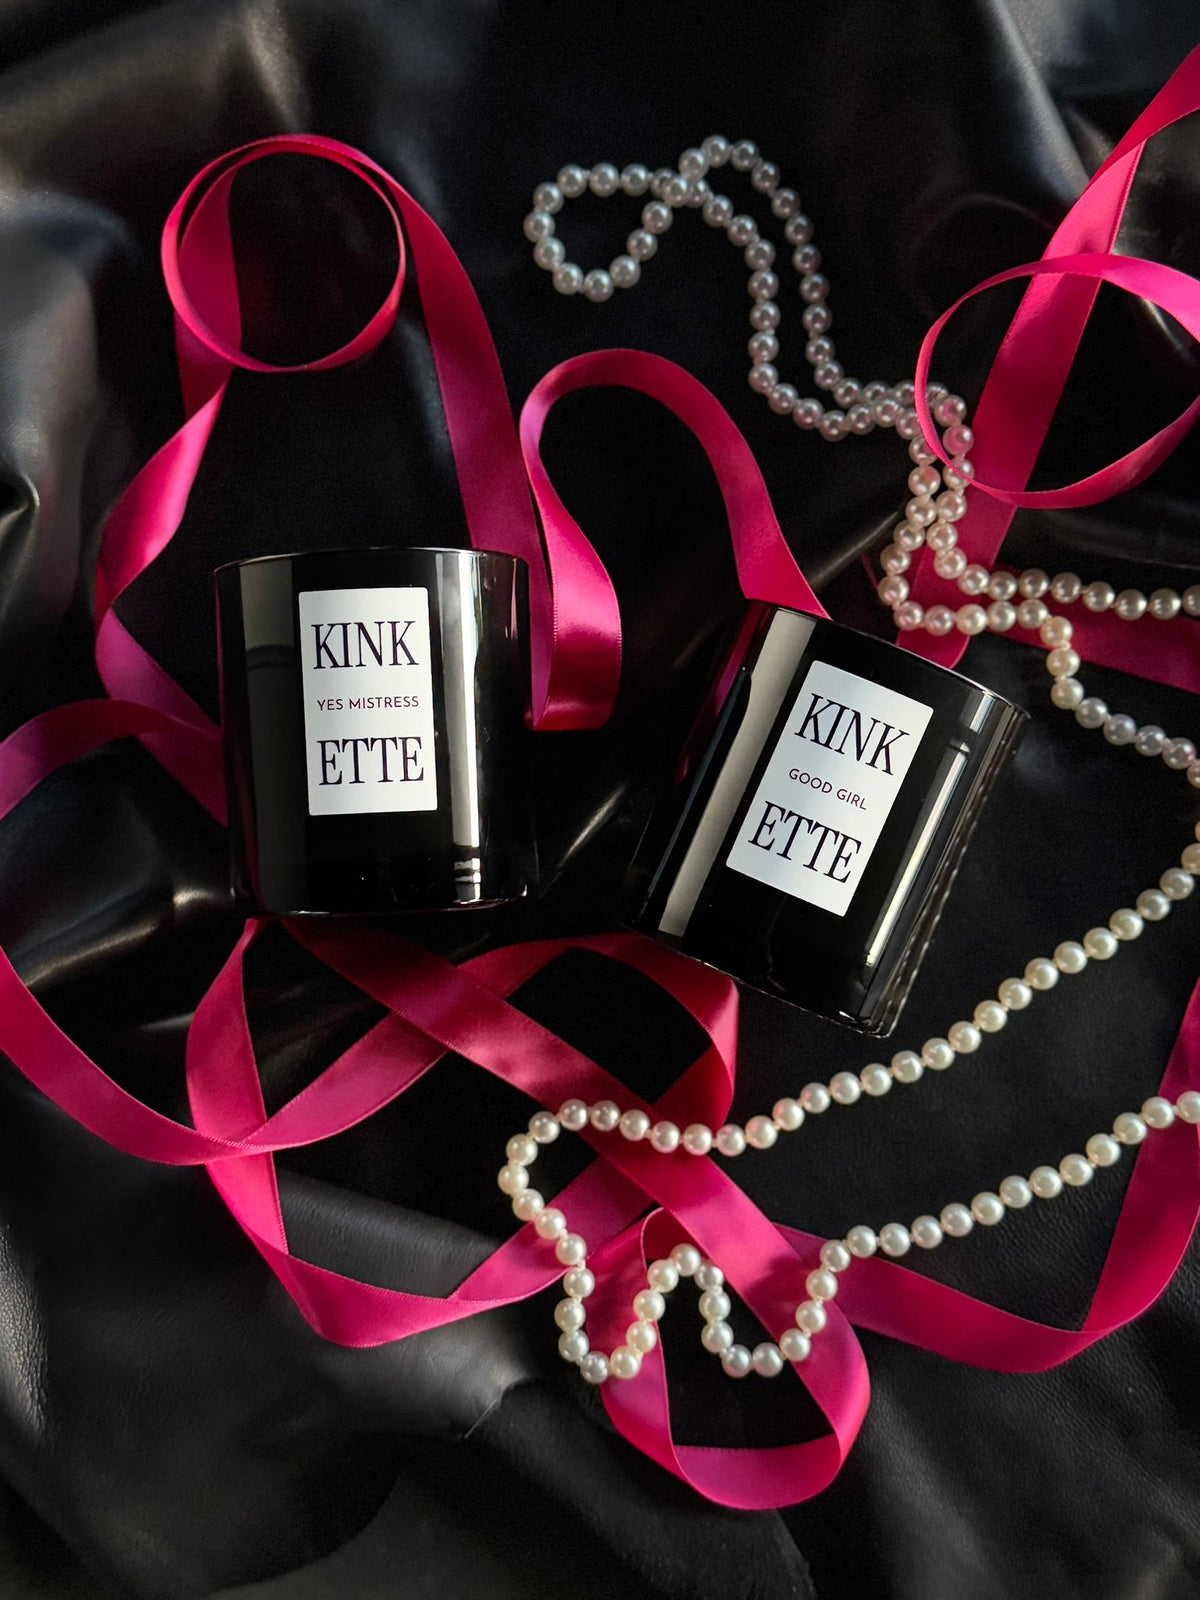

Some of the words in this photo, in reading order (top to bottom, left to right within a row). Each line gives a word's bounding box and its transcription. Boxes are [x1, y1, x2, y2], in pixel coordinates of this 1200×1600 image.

[311, 620, 420, 670] KINK
[316, 698, 344, 712] YES
[348, 695, 420, 710] MISTRESS
[794, 692, 911, 776] KINK
[316, 736, 424, 786] ETTE
[788, 768, 833, 794] GOOD
[836, 788, 867, 811] GIRL
[747, 800, 862, 884] ETTE
